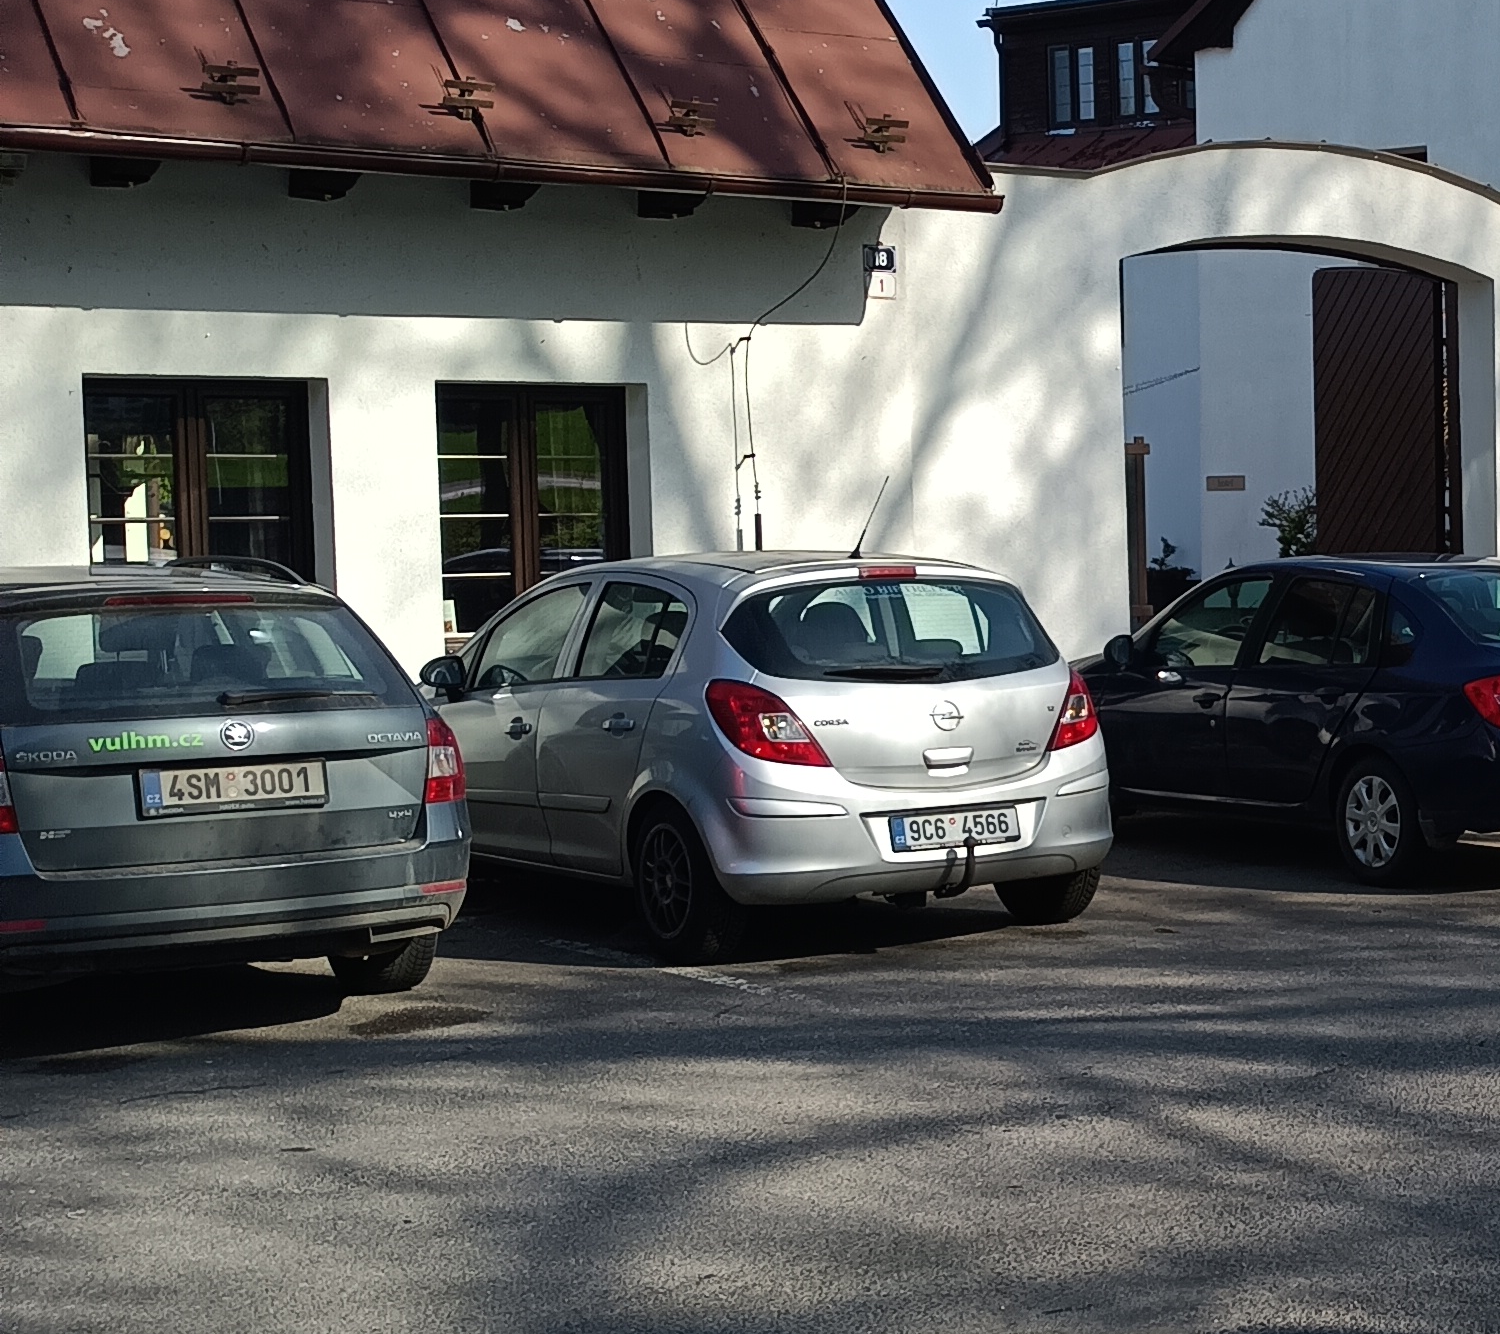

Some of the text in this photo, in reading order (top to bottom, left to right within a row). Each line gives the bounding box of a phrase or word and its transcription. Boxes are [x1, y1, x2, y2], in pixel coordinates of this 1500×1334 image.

[874, 251, 888, 267] 18
[879, 278, 885, 293] 1
[813, 718, 850, 727] CORSA
[88, 731, 205, 752] vulhm.cz
[367, 731, 423, 744] OCTAVIA
[15, 749, 78, 763] ŠKODA
[147, 766, 310, 804] CZ 4SM 3001
[909, 817, 947, 842] 9C6
[961, 812, 1010, 836] 4566
